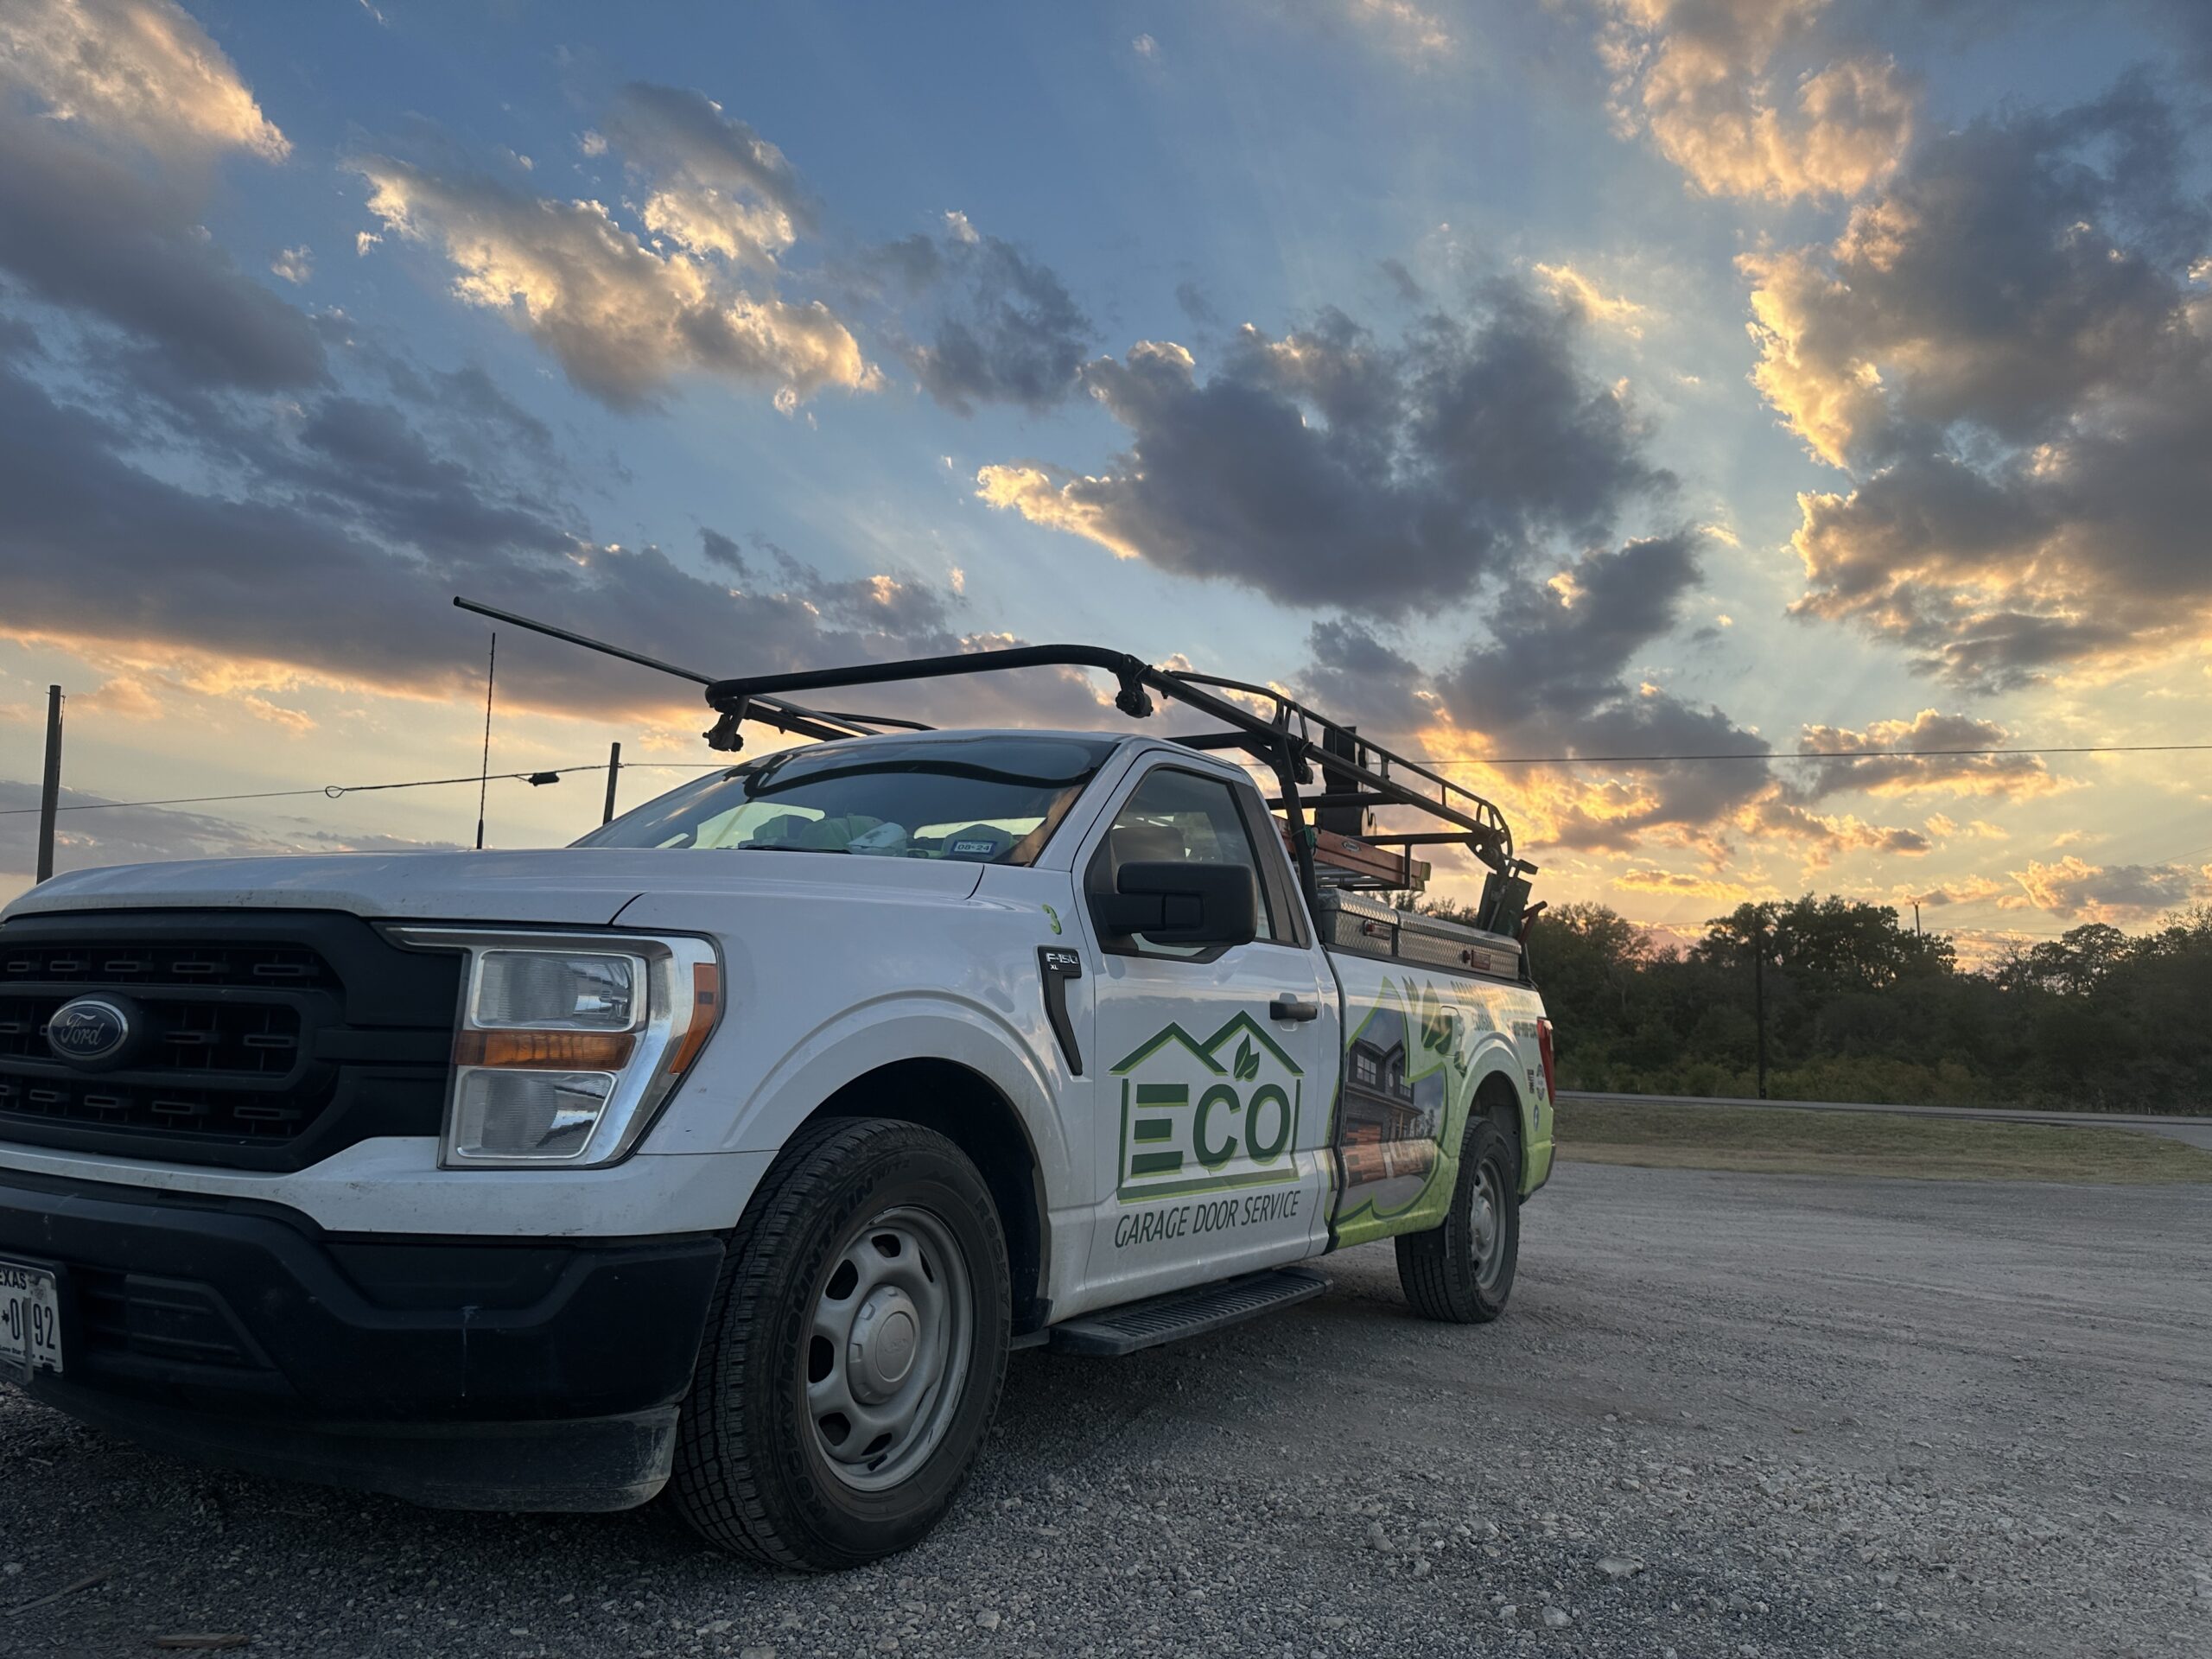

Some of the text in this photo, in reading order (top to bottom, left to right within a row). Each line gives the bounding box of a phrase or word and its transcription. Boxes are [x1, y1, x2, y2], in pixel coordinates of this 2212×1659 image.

[1042, 904, 1063, 935] 3
[1046, 952, 1079, 964] F-150
[60, 1012, 105, 1046] Ford
[1131, 1084, 1292, 1178] ECO
[1115, 1190, 1301, 1248] GARAGE DOOR SERVICE
[780, 1176, 874, 1382] MOUNTAIN
[780, 1389, 828, 1520] ROCKY
